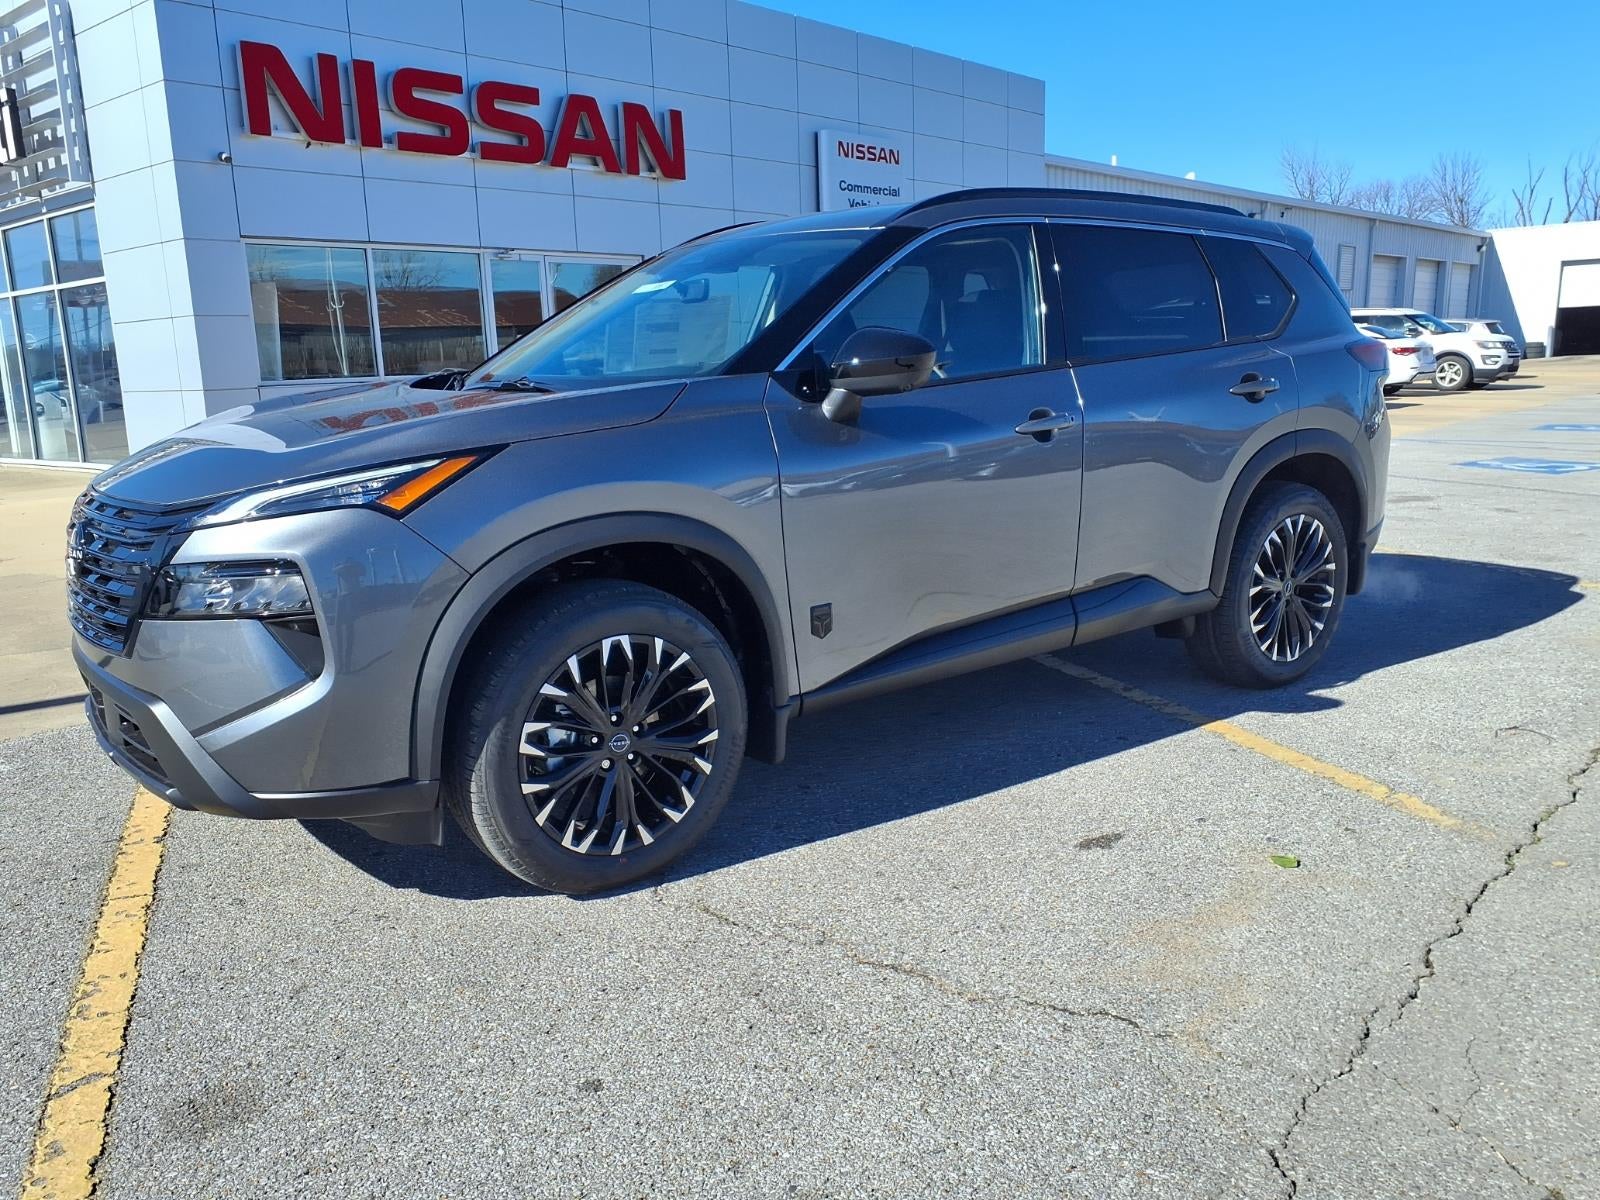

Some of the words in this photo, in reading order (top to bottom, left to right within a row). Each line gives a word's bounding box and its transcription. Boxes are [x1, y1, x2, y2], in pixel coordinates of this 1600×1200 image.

[235, 40, 687, 181] NISSAN
[837, 140, 900, 165] NISSAN
[839, 180, 900, 198] Commercial
